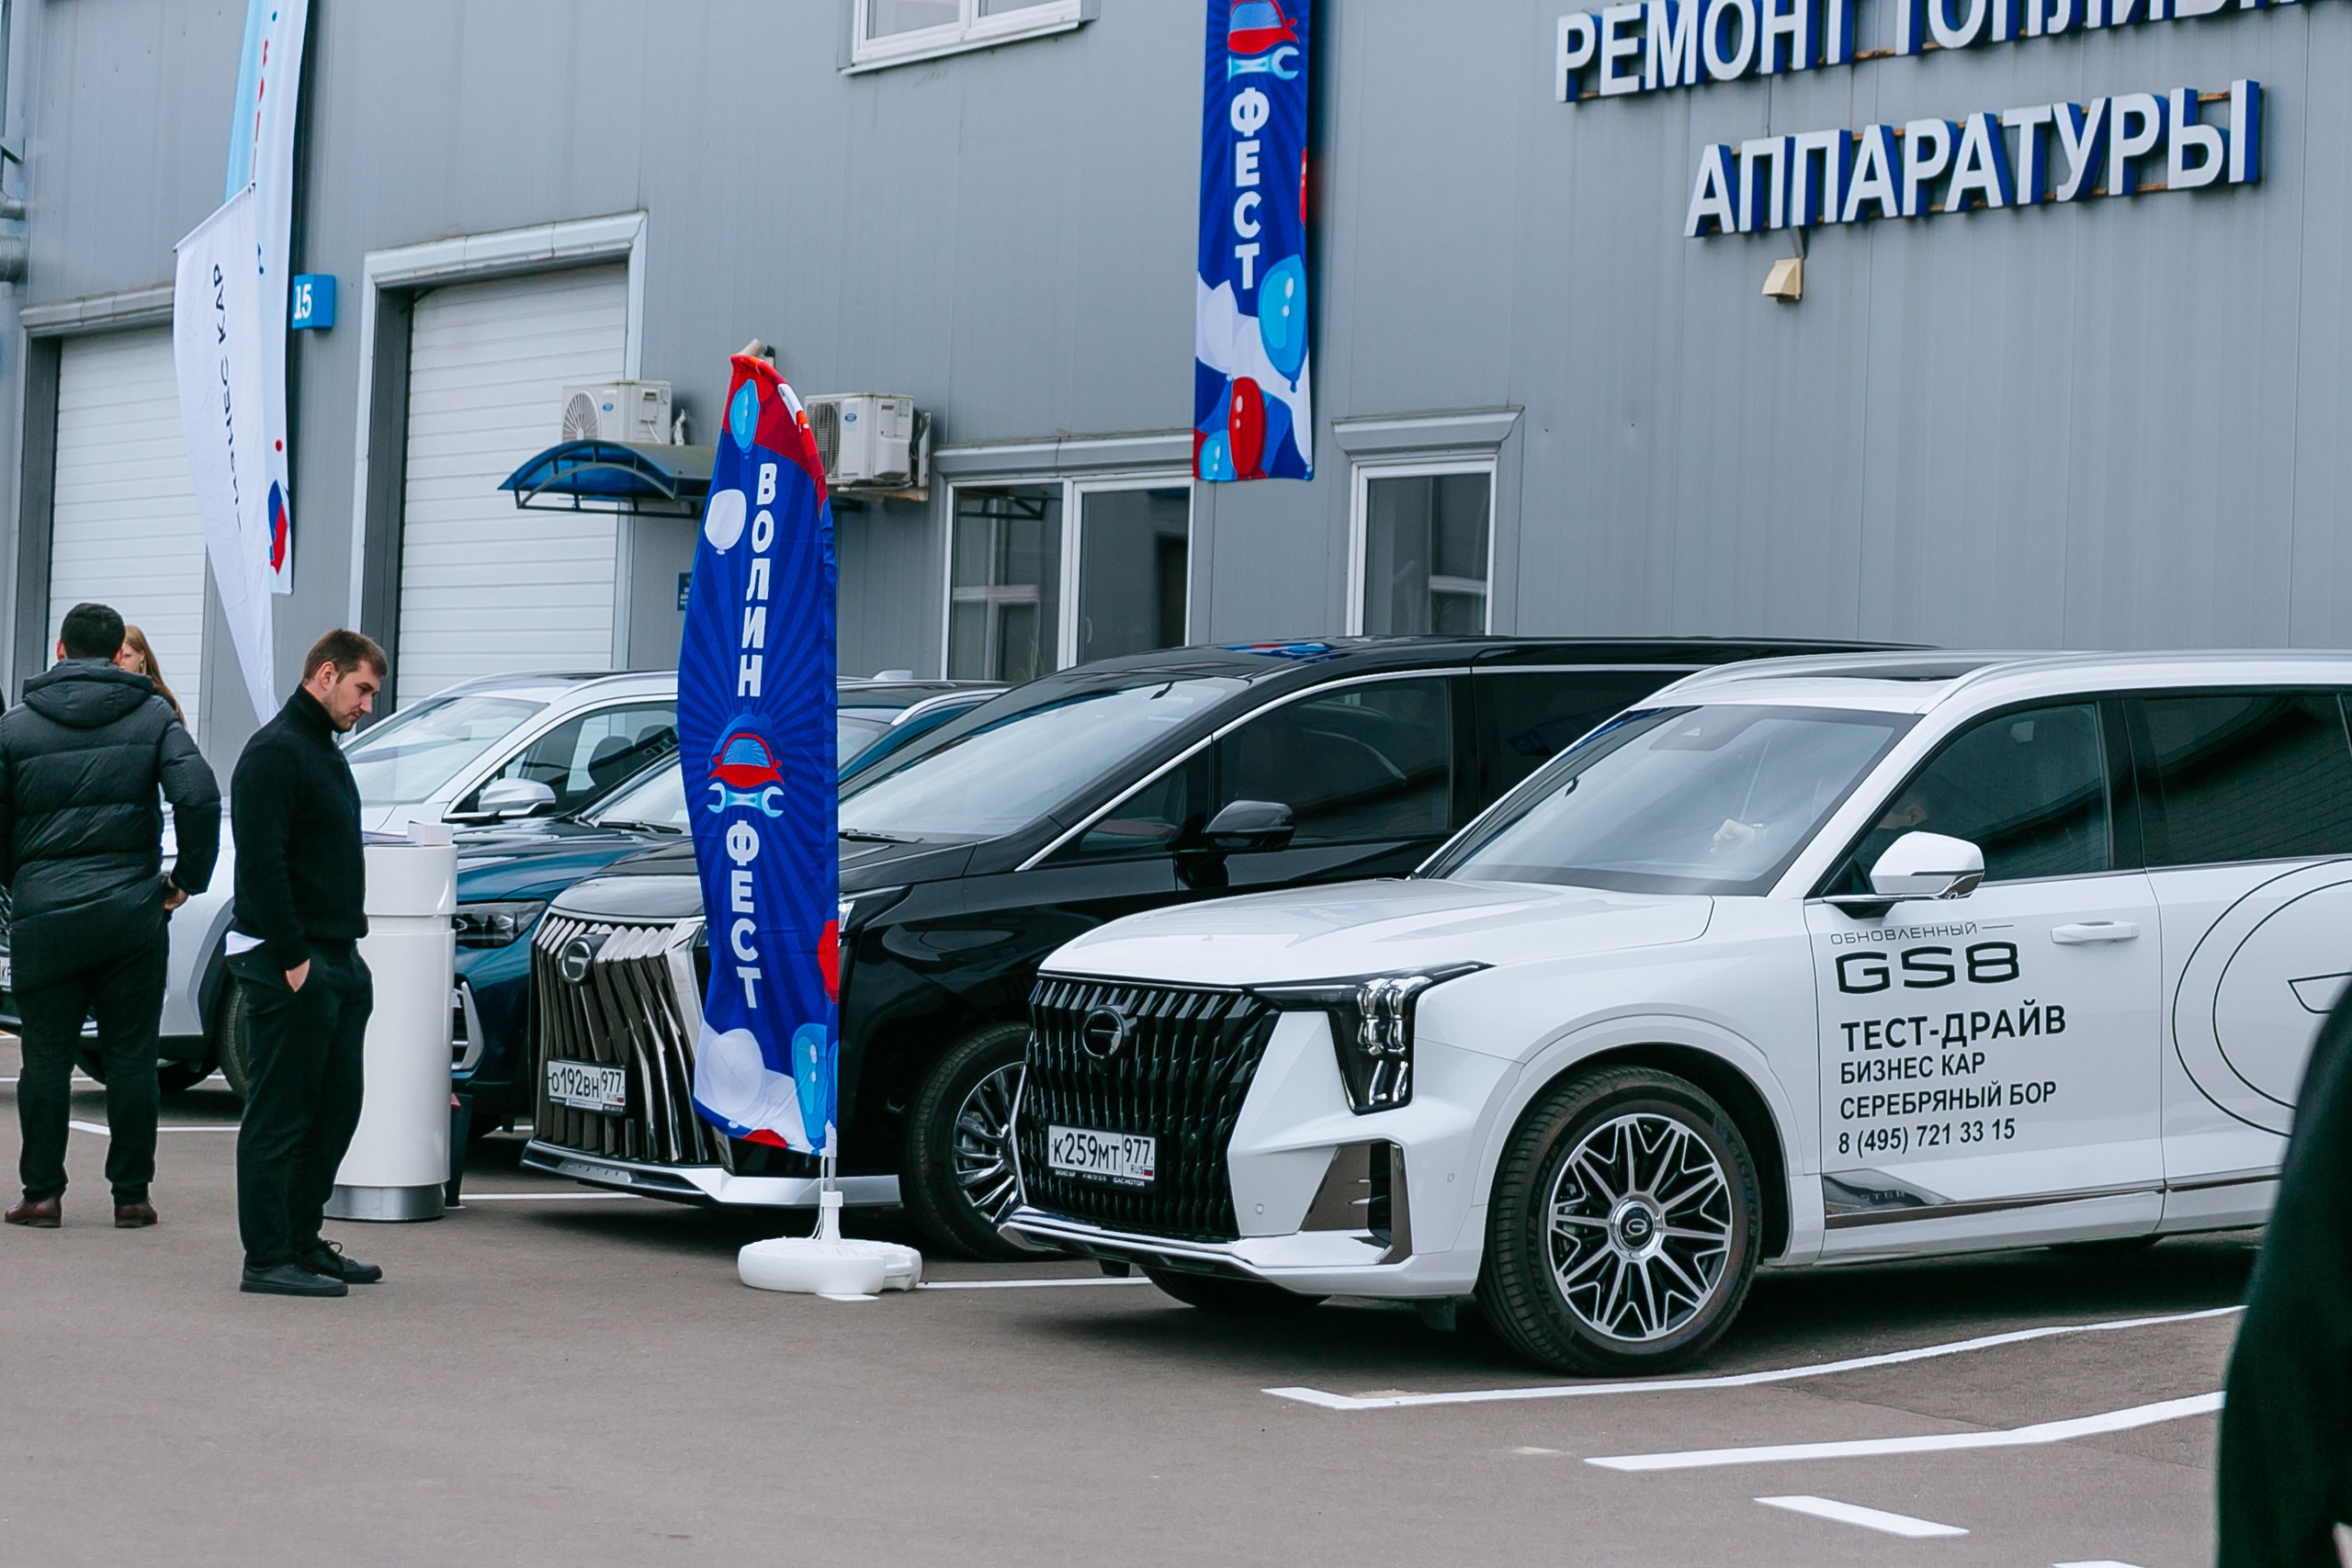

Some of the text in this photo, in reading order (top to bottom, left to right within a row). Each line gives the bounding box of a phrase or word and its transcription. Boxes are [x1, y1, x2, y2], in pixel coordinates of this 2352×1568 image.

[1685, 79, 2260, 237] АППАРАТУРЫ
[1230, 87, 1270, 289] ФЕСТ
[213, 264, 227, 344] КАР
[294, 284, 312, 320] 15
[738, 463, 777, 697] ВОЛИН
[726, 819, 763, 1009] ФЕСТ
[1830, 921, 1977, 945] ОБНОВЛЕННЫЙ
[1835, 941, 2020, 994] GS8
[1840, 998, 2066, 1052] ТЕСТ-ДРАЙВ
[1840, 1052, 1985, 1084] БИЗНЕС КАР
[1839, 1080, 2057, 1120] СЕРЕБРЯНЫЙ БОР
[1125, 1137, 1150, 1165] 977
[1838, 1118, 2016, 1158] 8 (495) 721 33 15
[1130, 1164, 1144, 1176] RUS
